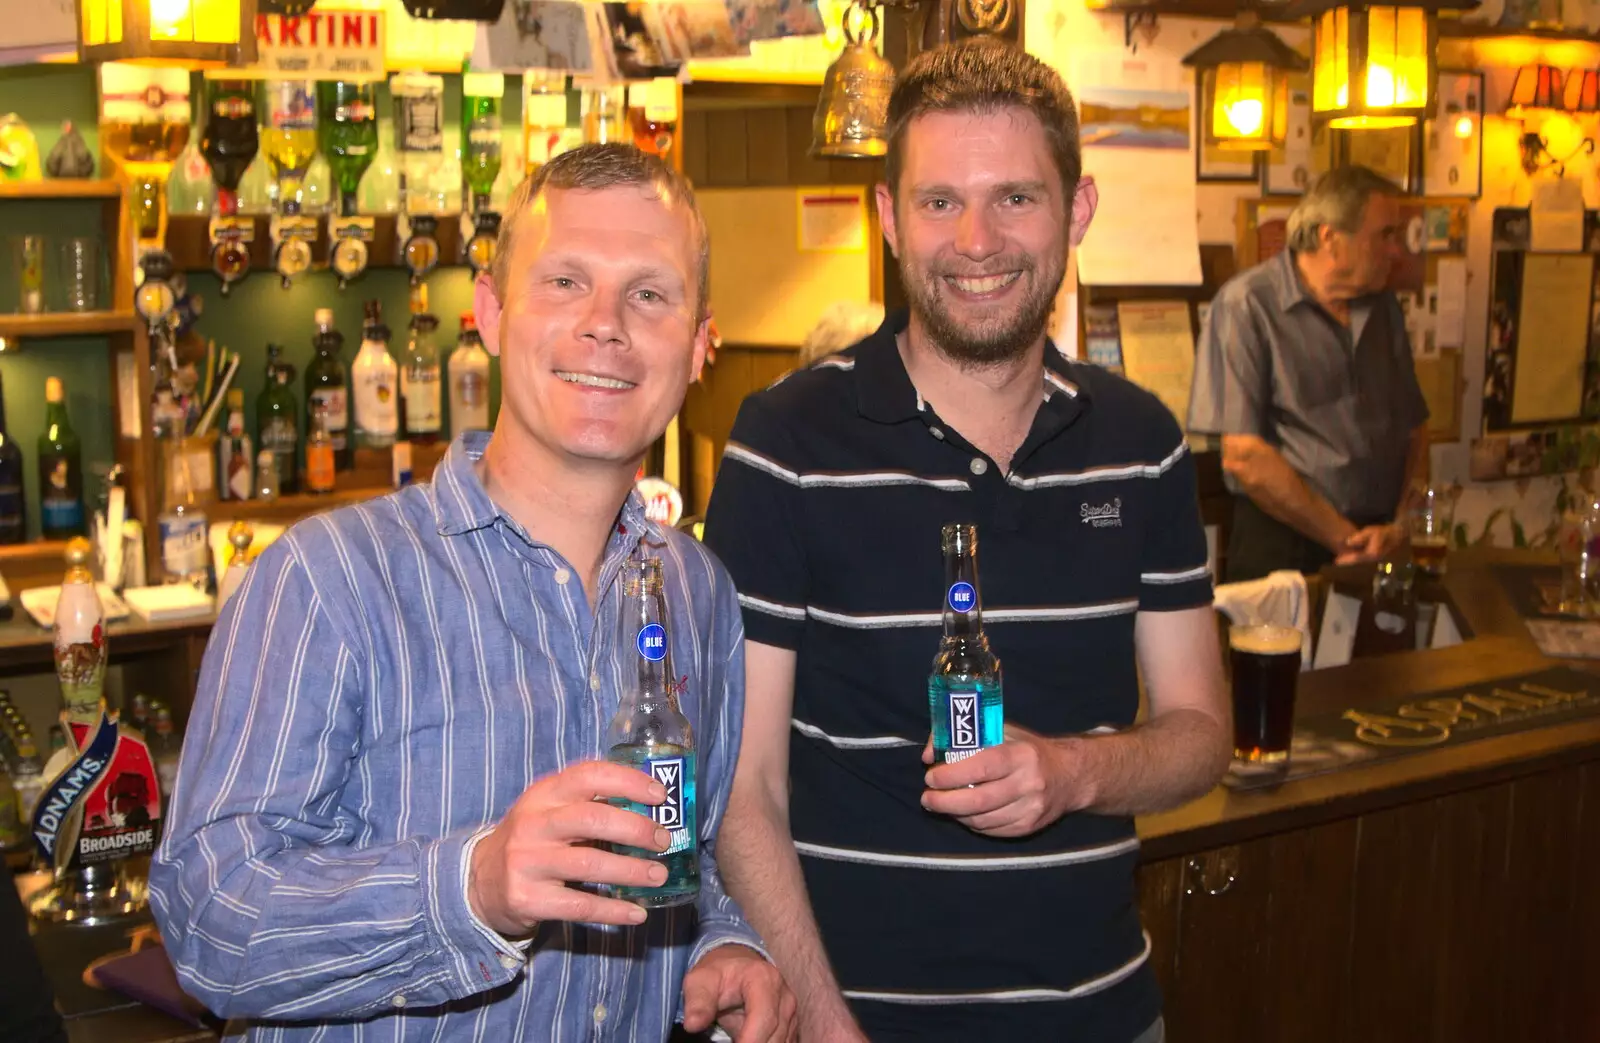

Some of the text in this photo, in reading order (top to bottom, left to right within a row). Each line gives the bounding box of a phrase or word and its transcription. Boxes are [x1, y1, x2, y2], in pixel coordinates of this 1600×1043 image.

[257, 13, 377, 46] ARTINI
[954, 592, 970, 602] BLUE
[645, 636, 663, 648] BLUE
[944, 748, 985, 765] ORIGIN
[80, 828, 153, 854] BROADSIDE
[670, 827, 692, 848] INAL
